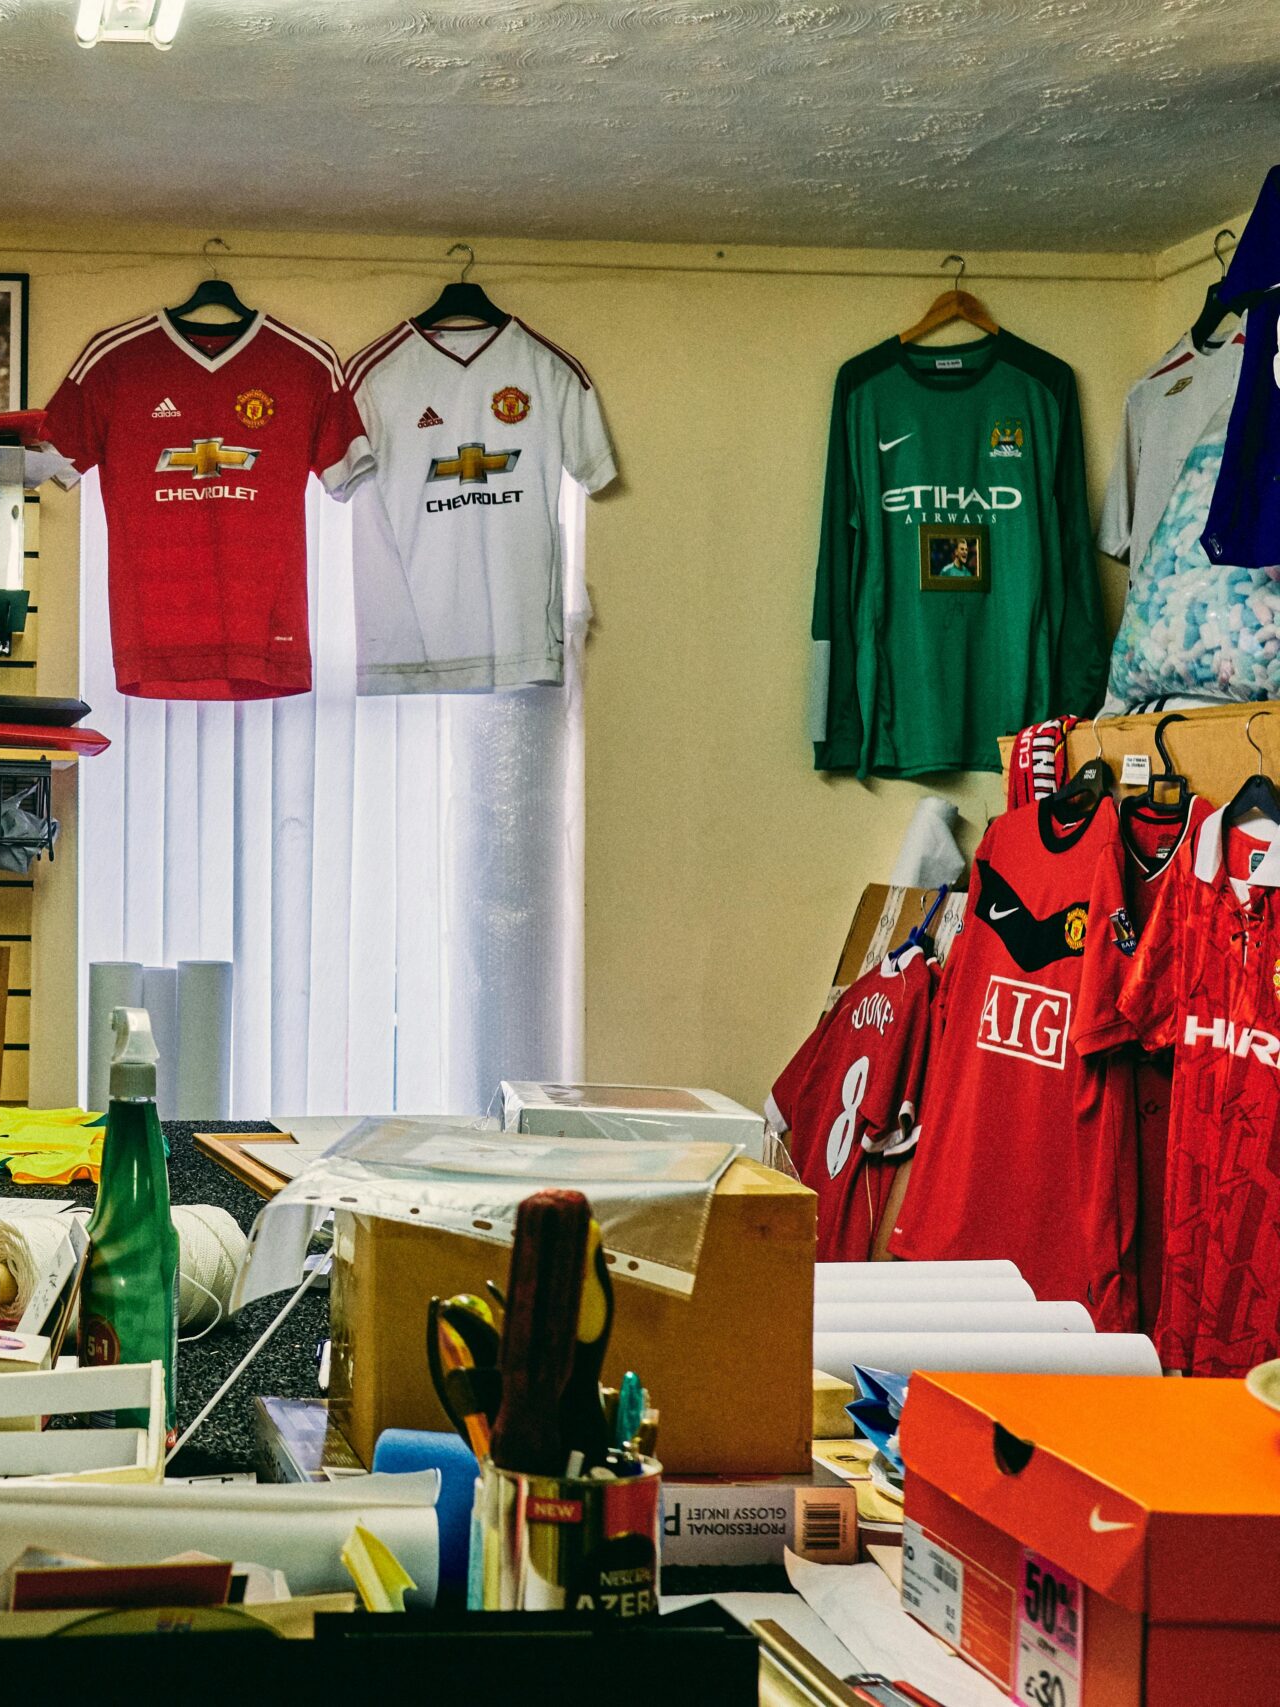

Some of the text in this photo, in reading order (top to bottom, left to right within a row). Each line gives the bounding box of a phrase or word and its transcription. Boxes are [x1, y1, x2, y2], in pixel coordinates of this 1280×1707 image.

[151, 410, 182, 419] adidas
[417, 417, 444, 429] adidas
[155, 485, 258, 502] CHEVROLET
[426, 490, 524, 513] CHEVROLET
[881, 485, 1022, 512] ETIHAD
[905, 512, 997, 524] AIRWAYS
[982, 985, 1061, 1057] AIG
[1184, 1015, 1280, 1070] HAR
[826, 1055, 869, 1180] 8
[533, 1502, 575, 1517] NEW
[687, 1507, 787, 1520] GLOSSY INKJET
[687, 1522, 786, 1536] PROFESSIONAL
[576, 1590, 656, 1617] AZER
